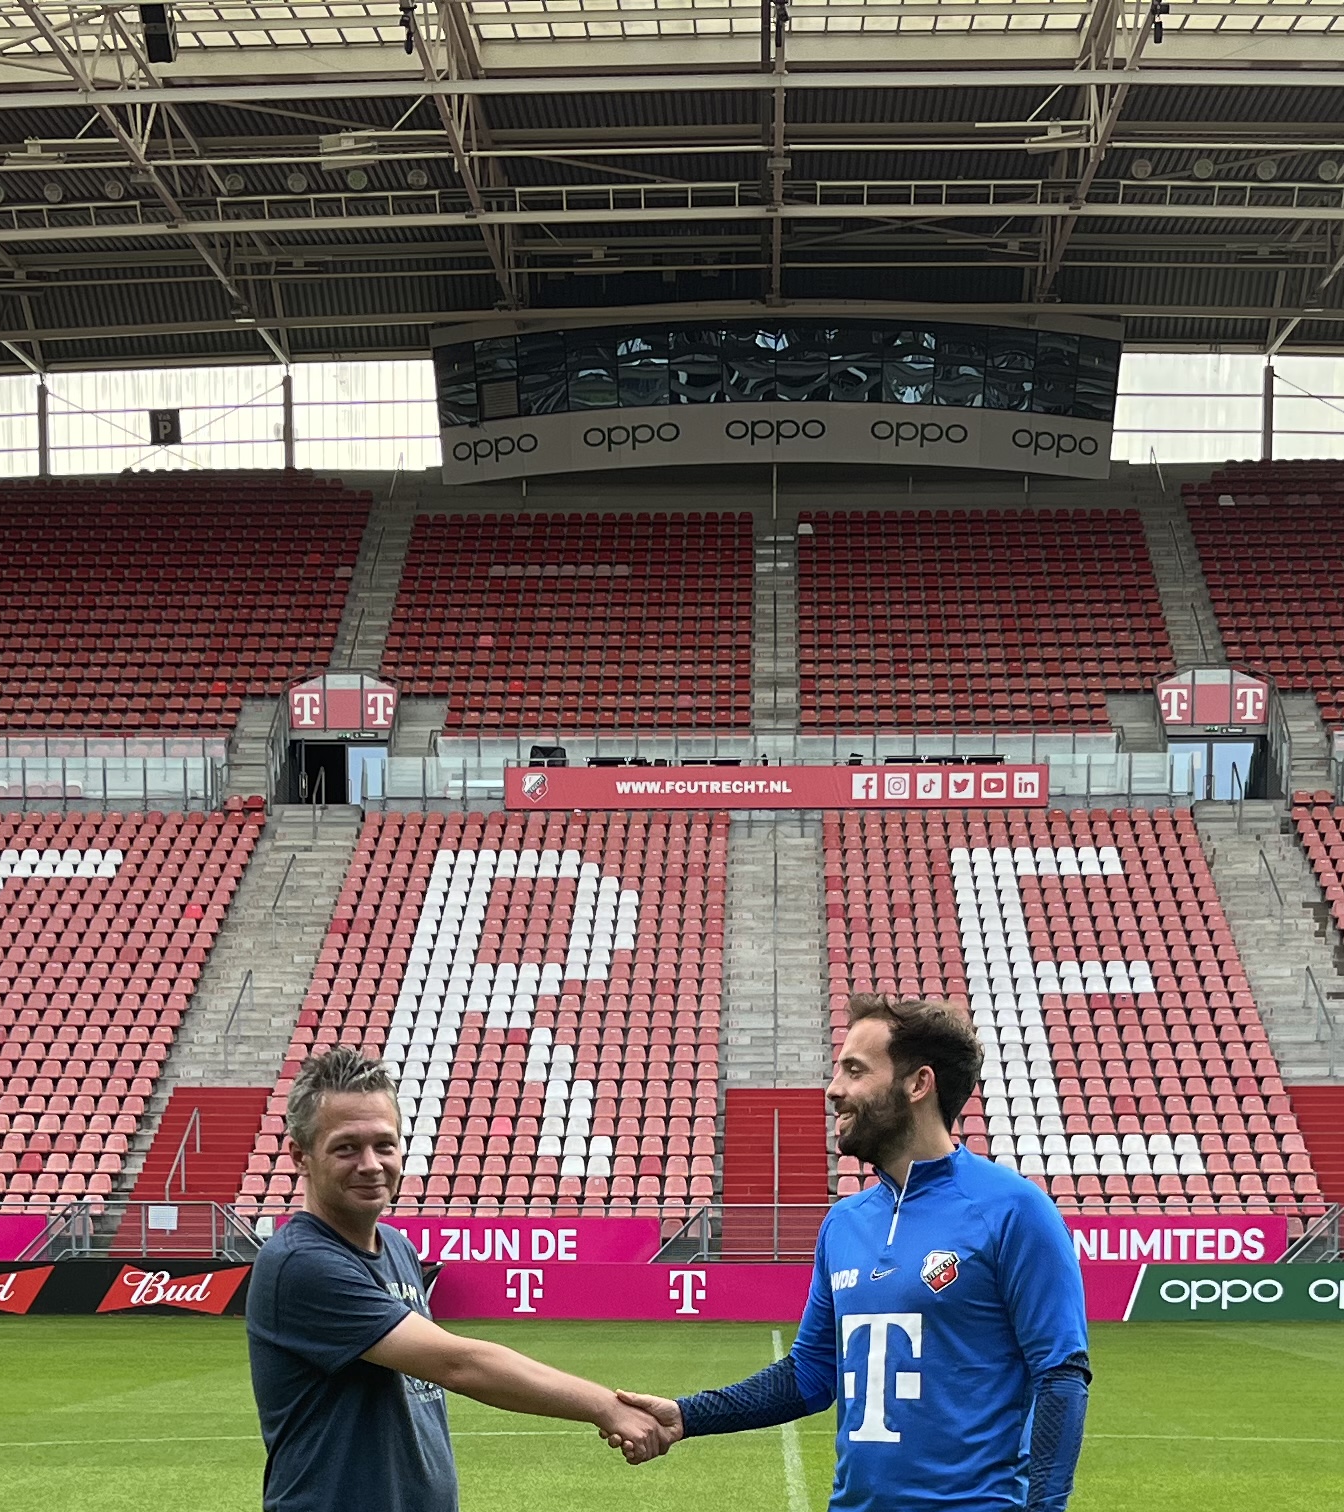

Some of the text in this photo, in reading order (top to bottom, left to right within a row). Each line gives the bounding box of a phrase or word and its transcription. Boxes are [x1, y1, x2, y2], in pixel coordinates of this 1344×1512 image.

[159, 421, 172, 440] P
[583, 420, 680, 451] oppo
[725, 418, 826, 446] oppo
[870, 419, 968, 447] oppo
[1012, 428, 1098, 458] oppo
[453, 431, 538, 466] oppo
[616, 781, 792, 794] WWW.FCUTRECHT.NL
[440, 1229, 519, 1261] ZIJN
[532, 1229, 577, 1260] DE
[1073, 1228, 1264, 1261] NLIMITEDS
[123, 1270, 213, 1304] Bud
[1160, 1279, 1283, 1310] oppo
